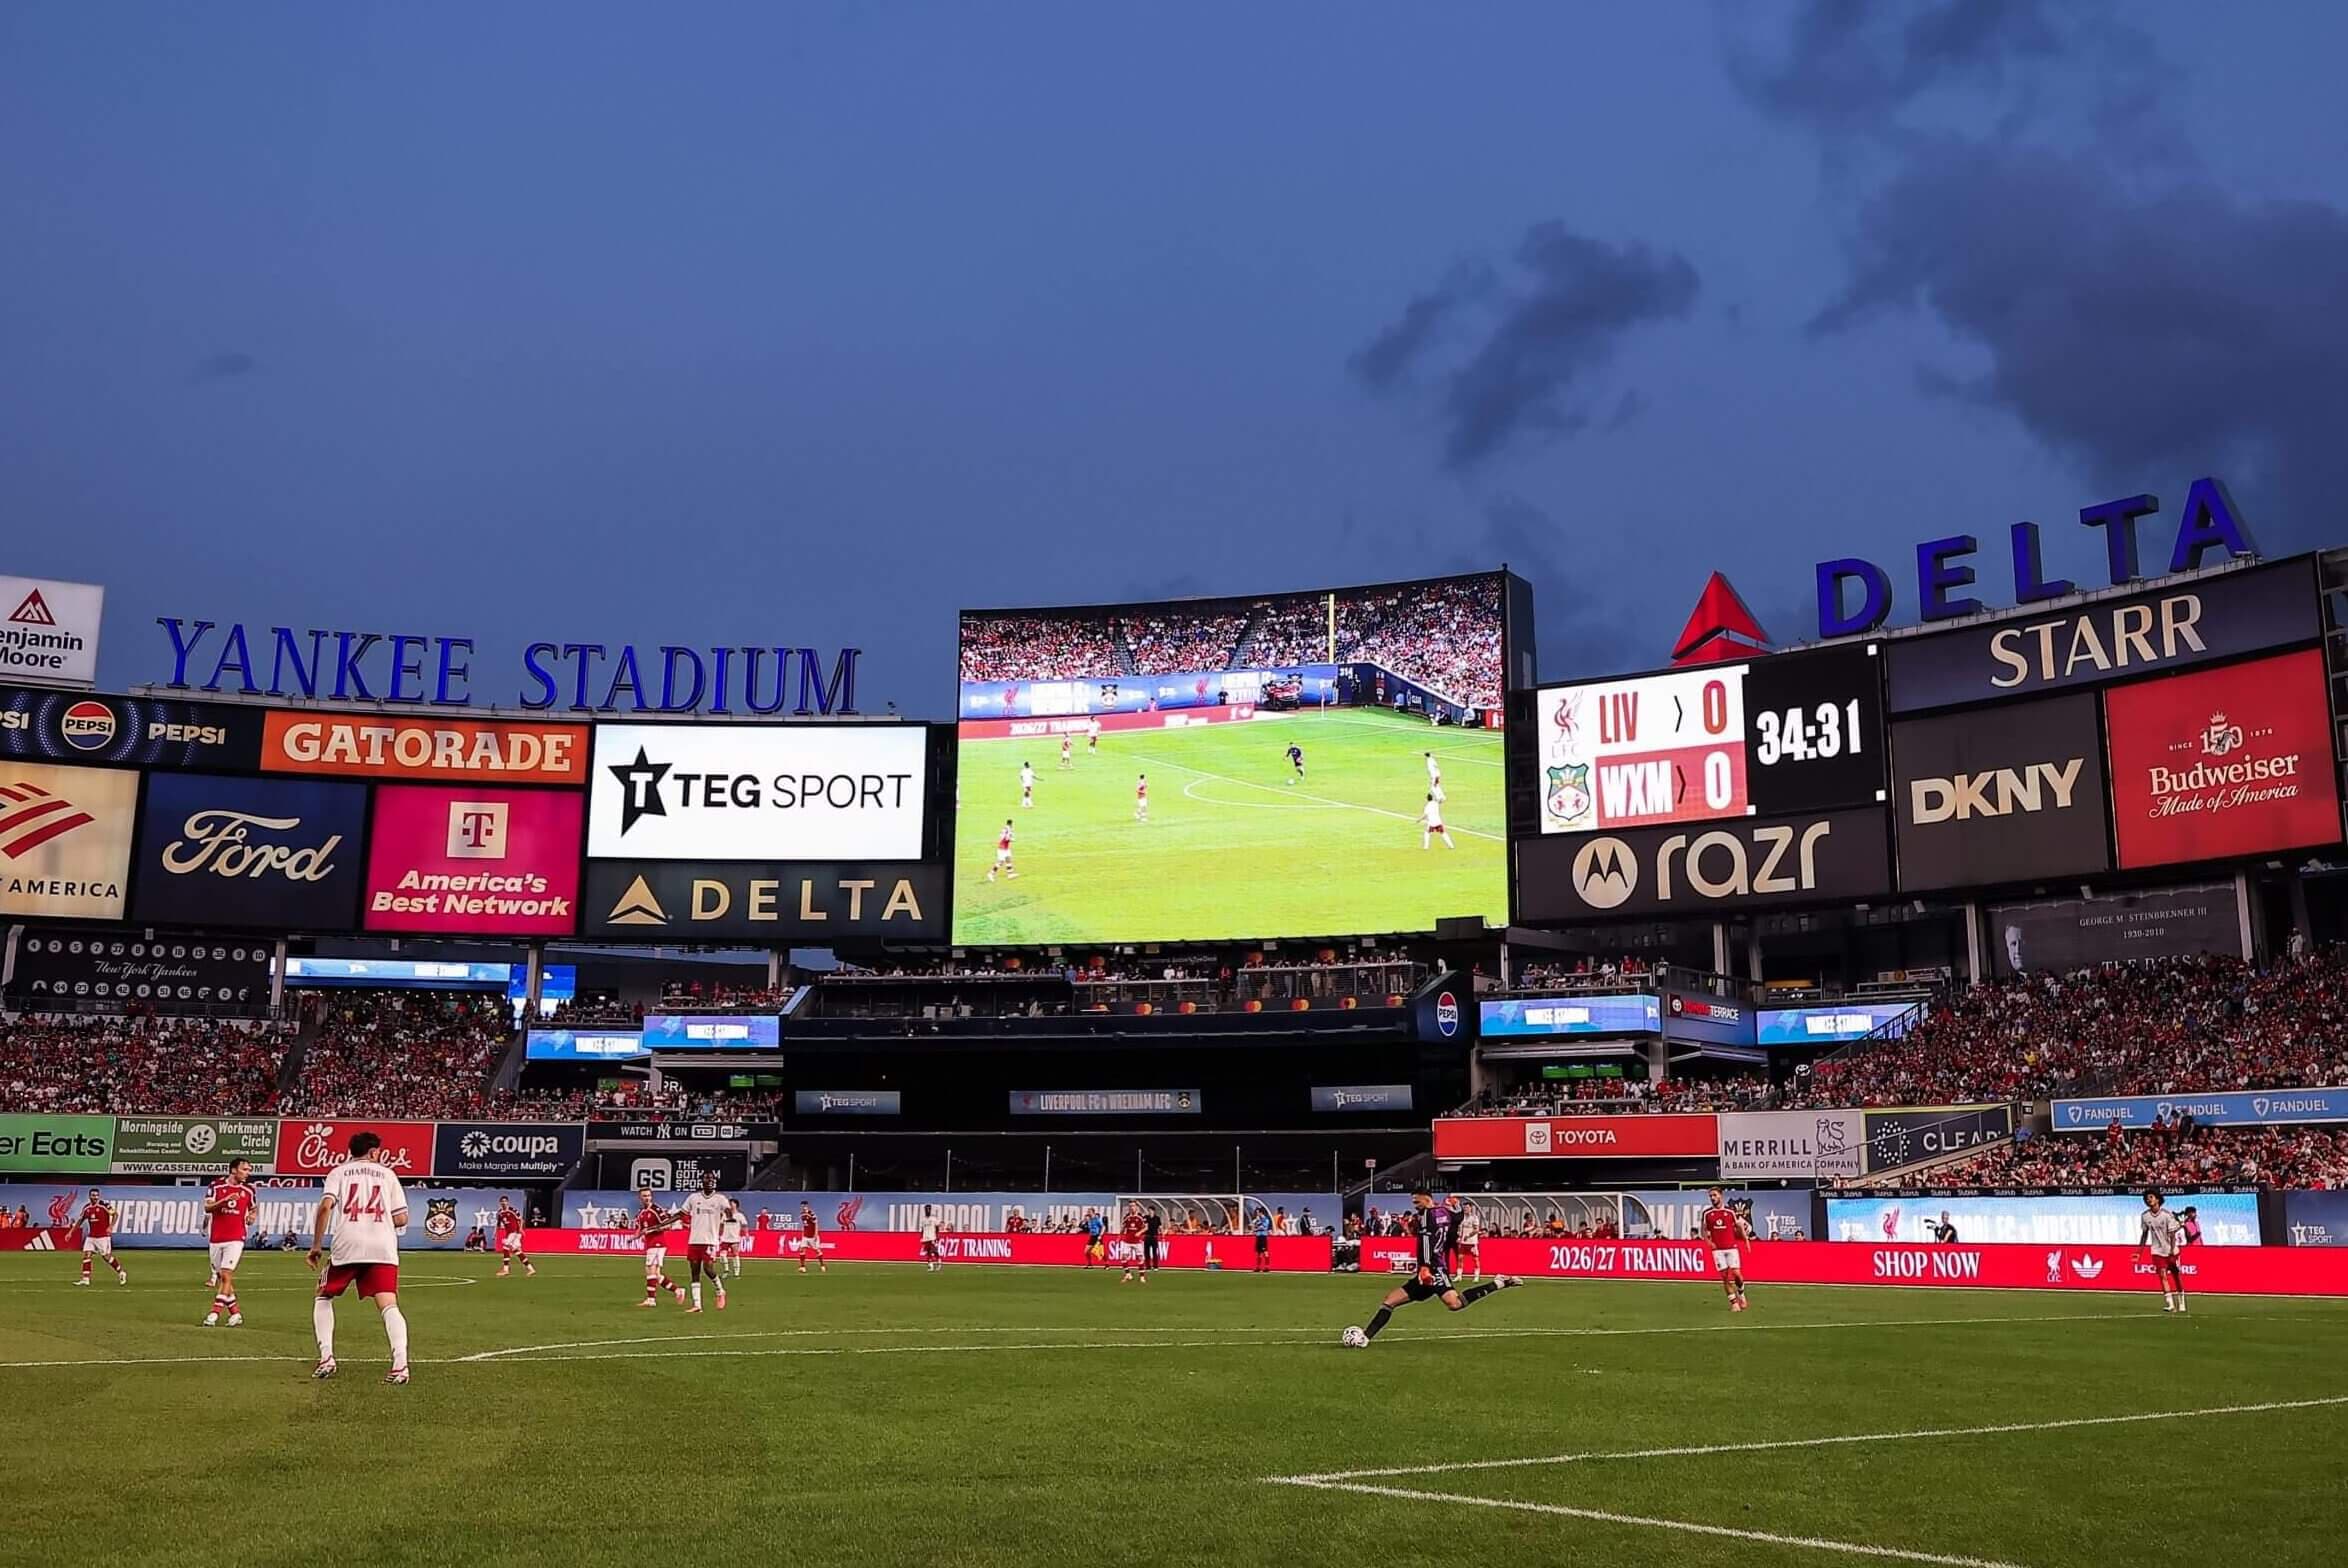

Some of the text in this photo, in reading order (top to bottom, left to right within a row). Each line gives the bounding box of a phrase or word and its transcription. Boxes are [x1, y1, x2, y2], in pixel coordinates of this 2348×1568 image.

[1816, 477, 2258, 638] DELTA
[1990, 594, 2206, 688] STARR
[155, 617, 862, 716] YANKEE STADIUM
[1599, 679, 1726, 744] LIV 0
[65, 719, 112, 733] PEPSI
[148, 723, 226, 745] PEPSI
[1756, 698, 1862, 766] 34:31
[282, 722, 572, 773] GATORADE
[2149, 754, 2299, 795] Budweiser
[673, 774, 912, 808] TEG SPORT
[1600, 751, 1733, 818] WXM 0
[1910, 758, 2084, 825] DKNY
[2149, 782, 2300, 818] Made of America
[161, 809, 343, 882] Ford
[1657, 820, 1831, 900] razr
[9, 879, 119, 899] AMERICA
[397, 869, 548, 893] America's
[372, 891, 569, 917] Best Network
[691, 879, 924, 921] DELTA
[2080, 916, 2114, 927] GEORGE
[2129, 908, 2195, 922] STEINBRENNER
[2123, 928, 2165, 939] 1930-2010
[95, 960, 198, 981] New York Yankees
[1438, 1008, 1457, 1020] PEPSI
[1040, 1094, 1087, 1110] LIVERPOOL
[1154, 1093, 1170, 1110] AFC
[2272, 1099, 2329, 1112] FANDUEL
[2085, 1108, 2133, 1121] FANDUEL
[121, 1120, 184, 1136] Morningside
[218, 1121, 273, 1135] Workmen's
[621, 1127, 652, 1136] WATCH
[675, 1127, 688, 1136] ON
[1556, 1130, 1616, 1145] TOYOTA
[32, 1131, 105, 1157] Eats
[241, 1135, 271, 1147] Circle
[492, 1136, 558, 1159] coupa
[1724, 1139, 1812, 1157] MERRILL
[459, 1161, 482, 1169] Make
[484, 1161, 518, 1172] Margins
[676, 1160, 698, 1170] THE
[1733, 1161, 1756, 1169] BANK
[1772, 1160, 1813, 1169] AMERICA
[1815, 1160, 1860, 1169] COMPANY
[637, 1169, 665, 1188] GS
[343, 1184, 385, 1222] 44
[775, 1214, 792, 1222] TEG
[1781, 1216, 1796, 1225] TEG
[2308, 1226, 2326, 1235] TEG
[2308, 1235, 2334, 1244] SPORT
[963, 1239, 1012, 1257] TRAINING
[1373, 1251, 1387, 1259] LFC
[1550, 1246, 1705, 1272] 2026/27 TRAINING
[1874, 1251, 1981, 1278] SHOP NOW
[2134, 1264, 2156, 1274] LFC
